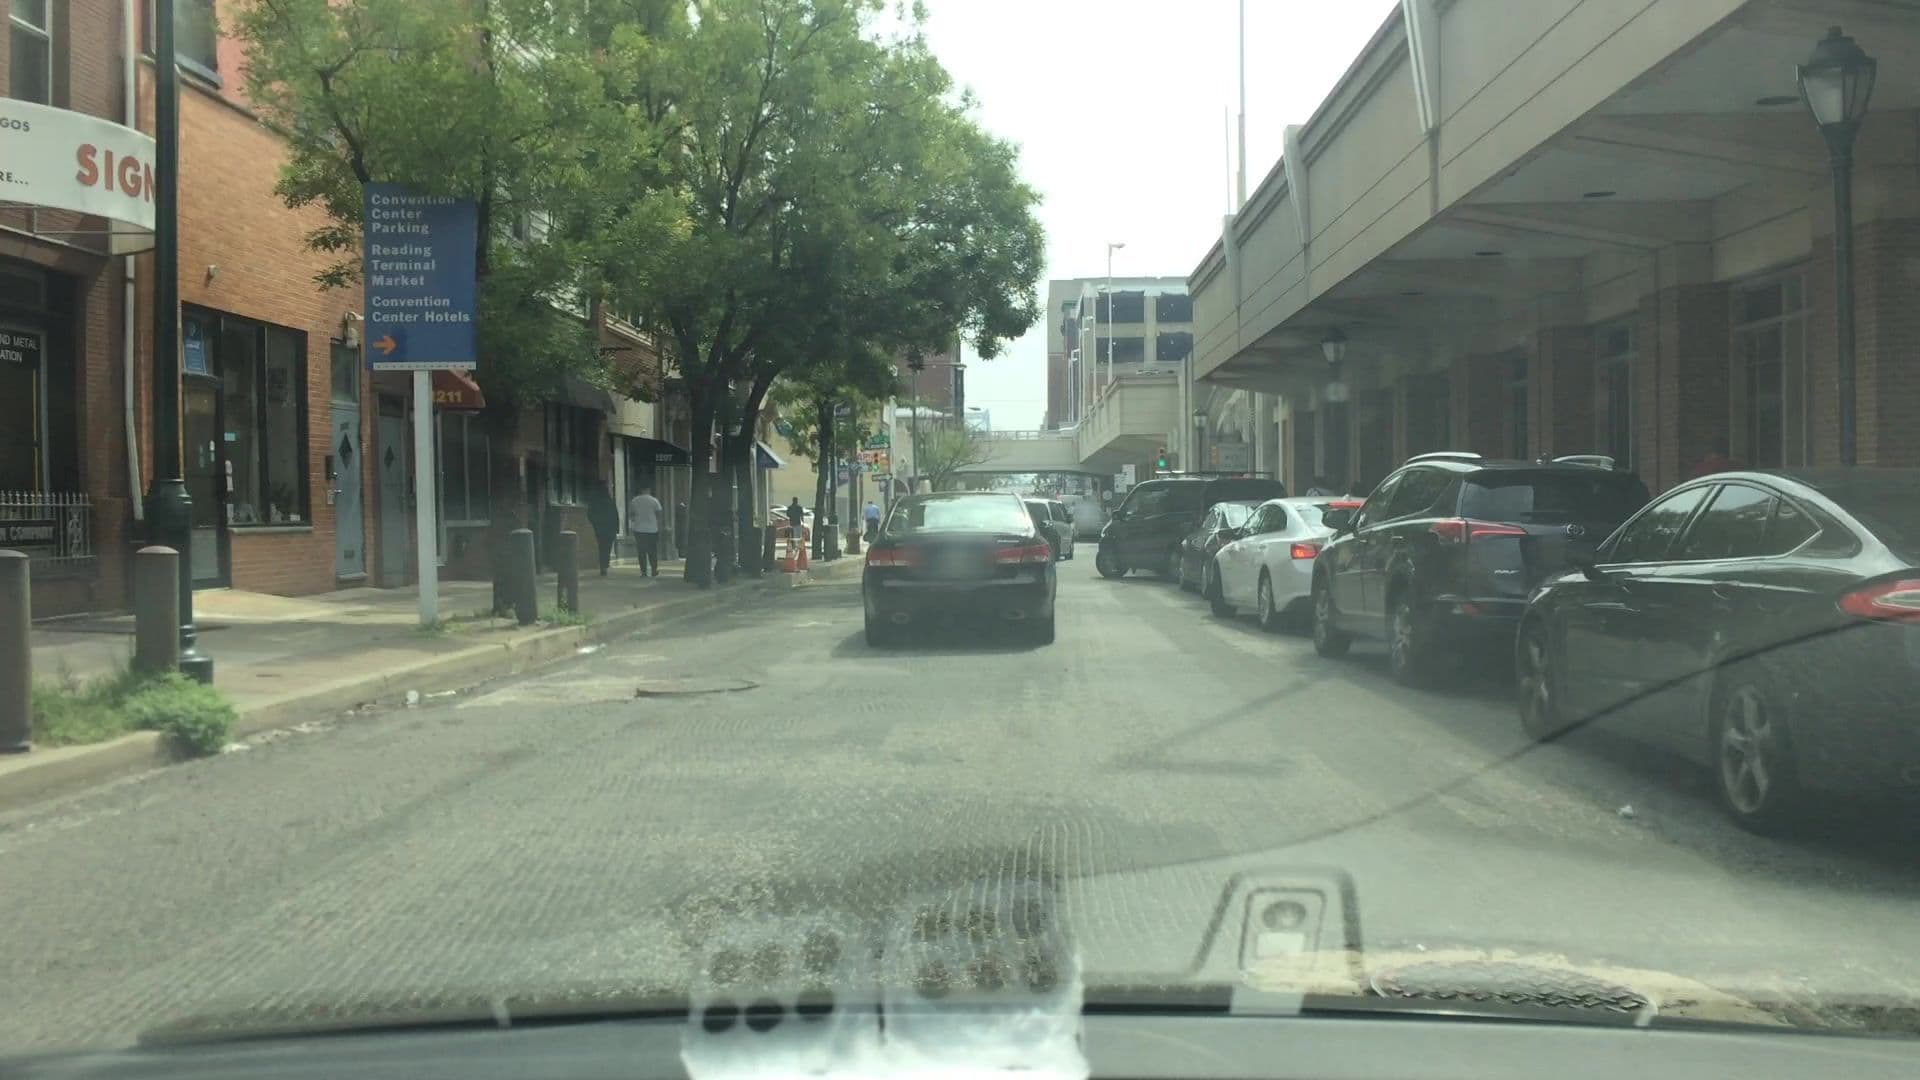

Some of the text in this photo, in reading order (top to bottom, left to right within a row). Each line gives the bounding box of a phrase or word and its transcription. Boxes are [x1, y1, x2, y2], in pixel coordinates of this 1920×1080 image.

[371, 208, 422, 220] Center
[371, 222, 430, 235] Parking
[371, 244, 432, 257] Reading
[371, 260, 436, 271] Terminal
[371, 275, 425, 286] Market
[372, 296, 450, 307] Convention
[372, 311, 471, 322] Center Hotels
